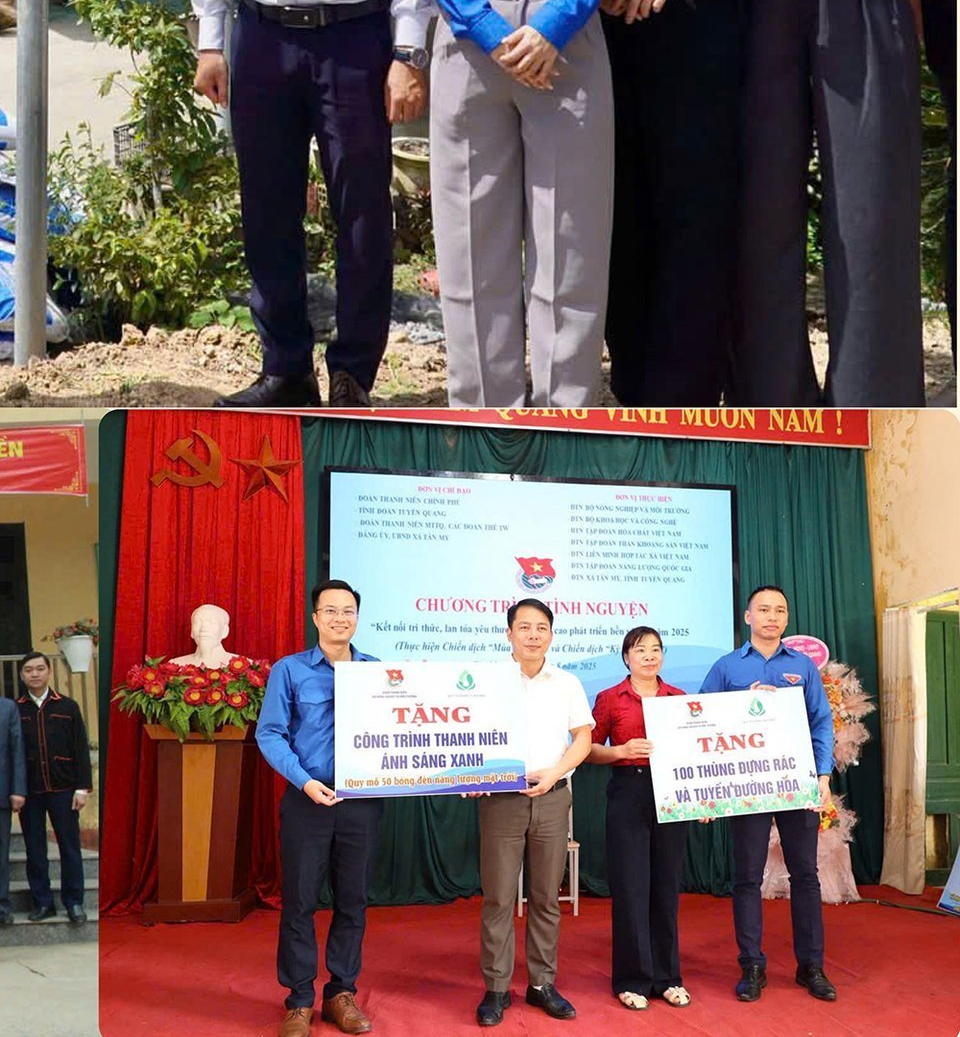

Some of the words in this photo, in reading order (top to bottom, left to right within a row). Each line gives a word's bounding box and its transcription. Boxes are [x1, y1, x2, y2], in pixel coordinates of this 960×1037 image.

[416, 596, 486, 613] CHƯƠNG
[586, 601, 648, 619] NGUYỆN
[445, 624, 457, 633] lan
[569, 627, 587, 636] phát
[671, 628, 689, 636] 2025
[392, 703, 471, 727] TẶNG
[353, 732, 389, 749] CÔNG
[393, 731, 430, 748] TRÌNH
[434, 732, 474, 747] THANH
[479, 729, 508, 746] NIÊN
[697, 732, 765, 754] TẶNG
[381, 753, 408, 770] ÁNH
[412, 752, 446, 769] SÁNG
[450, 753, 484, 767] XANH
[673, 766, 694, 780] 100
[697, 761, 735, 778] THÙNG
[738, 759, 770, 777] ĐỰNG
[773, 755, 796, 770] RÁC
[345, 778, 364, 789] (Quy
[382, 777, 392, 786] 50
[394, 776, 415, 788] bóng
[416, 774, 432, 785] đèn
[457, 772, 481, 785] lượng
[675, 788, 691, 803] VÀ
[694, 781, 732, 801] TUYẾN
[734, 780, 774, 797] ĐƯỜNG
